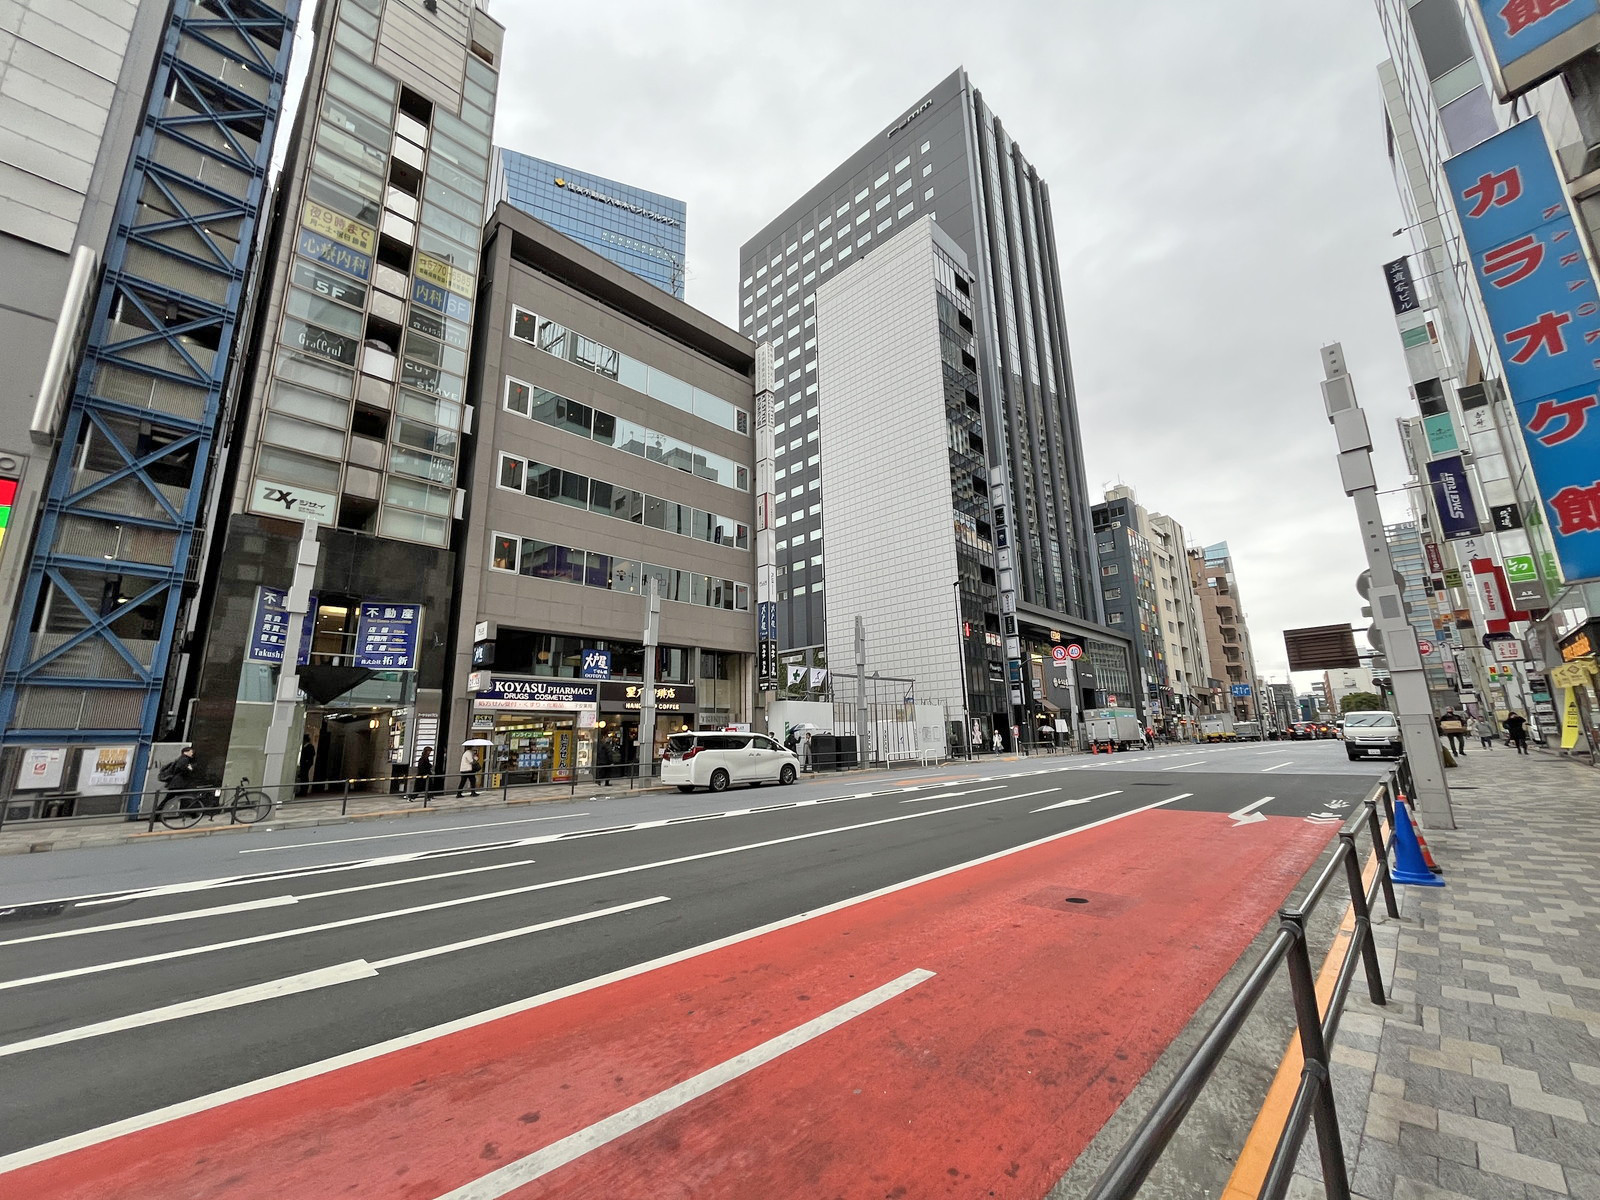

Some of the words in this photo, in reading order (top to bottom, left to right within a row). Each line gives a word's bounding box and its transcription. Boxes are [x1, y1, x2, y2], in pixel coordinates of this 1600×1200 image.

[303, 238, 367, 276] 心療内科
[416, 285, 442, 307] 内科
[448, 299, 467, 315] 6F
[405, 362, 430, 376] CUT
[416, 381, 459, 401] SHAVE
[263, 487, 298, 510] ZXY
[1507, 559, 1529, 572] レイク
[366, 607, 415, 619] 不動産
[1071, 648, 1079, 656] 40
[584, 652, 609, 670] 大戸屋
[494, 681, 547, 693] KOYASU
[547, 686, 594, 696] PHARMACY
[503, 692, 529, 700] DRUGS
[534, 693, 574, 701] COSMETICS
